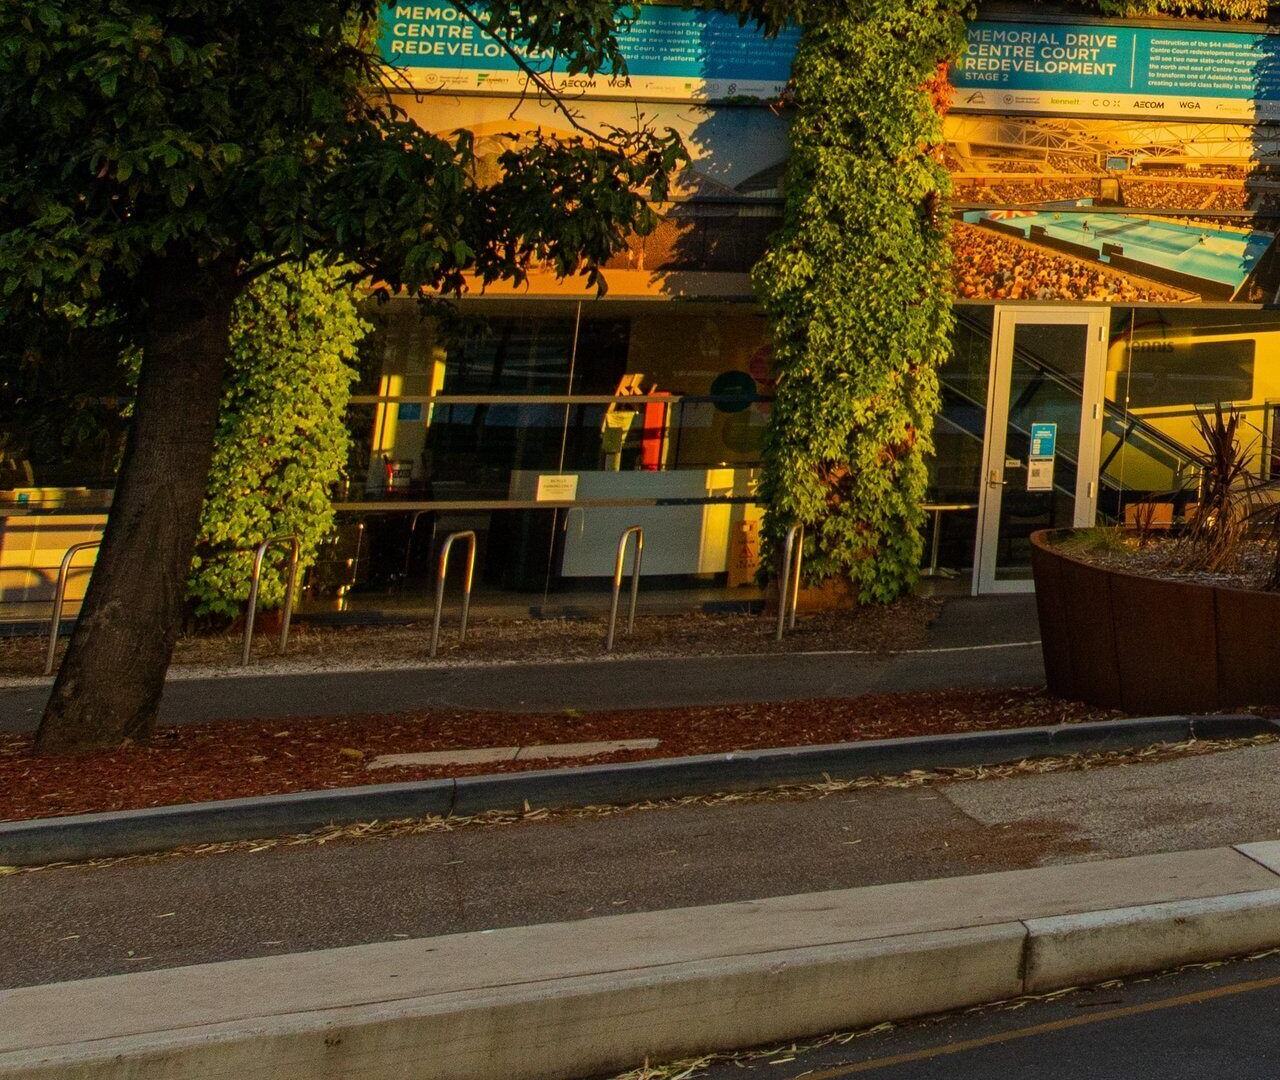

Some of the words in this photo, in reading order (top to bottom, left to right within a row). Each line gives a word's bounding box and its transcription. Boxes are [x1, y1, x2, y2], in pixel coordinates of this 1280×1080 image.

[393, 23, 475, 39] CENTRE
[967, 29, 1060, 45] MEMORIAL
[1065, 33, 1117, 48] DRIVE
[1151, 38, 1189, 47] Construction
[966, 43, 1035, 58] CENTRE
[1040, 46, 1100, 61] COURT
[1190, 49, 1235, 58] redevelopment
[1200, 58, 1245, 66] state-of-the-art
[965, 58, 1117, 76] REDEVELOPMENT
[965, 72, 999, 82] STAGE
[1002, 73, 1009, 82] 2
[560, 80, 597, 88] AECOM
[1148, 80, 1173, 88] creating
[1213, 82, 1233, 90] facility
[1051, 97, 1080, 106] kennett
[1133, 100, 1165, 109] AECOM
[1179, 101, 1201, 110] WGA
